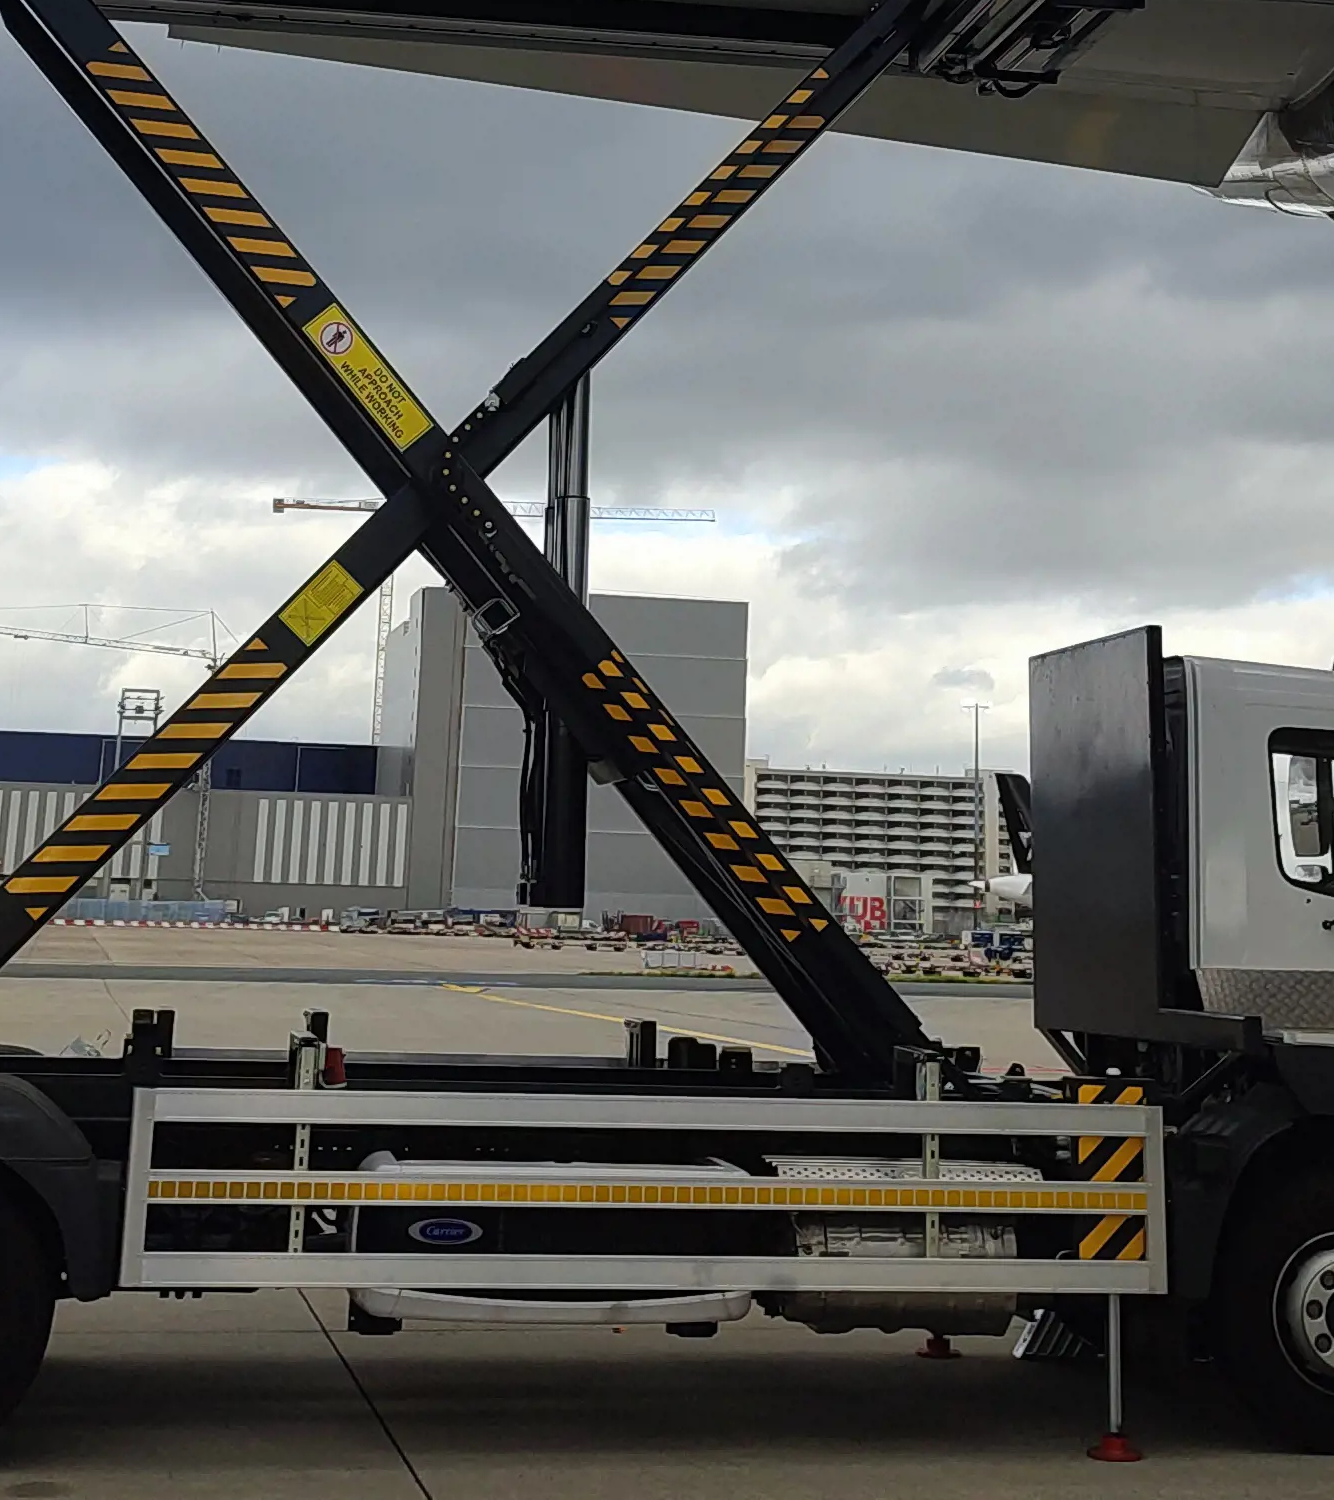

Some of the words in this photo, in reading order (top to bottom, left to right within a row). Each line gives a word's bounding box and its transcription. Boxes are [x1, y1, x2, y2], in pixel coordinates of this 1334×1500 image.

[340, 360, 369, 395] WHILE
[365, 391, 404, 439] WORKING
[358, 367, 404, 421] APPROACH
[374, 367, 389, 384] DO
[386, 382, 407, 404] NOT
